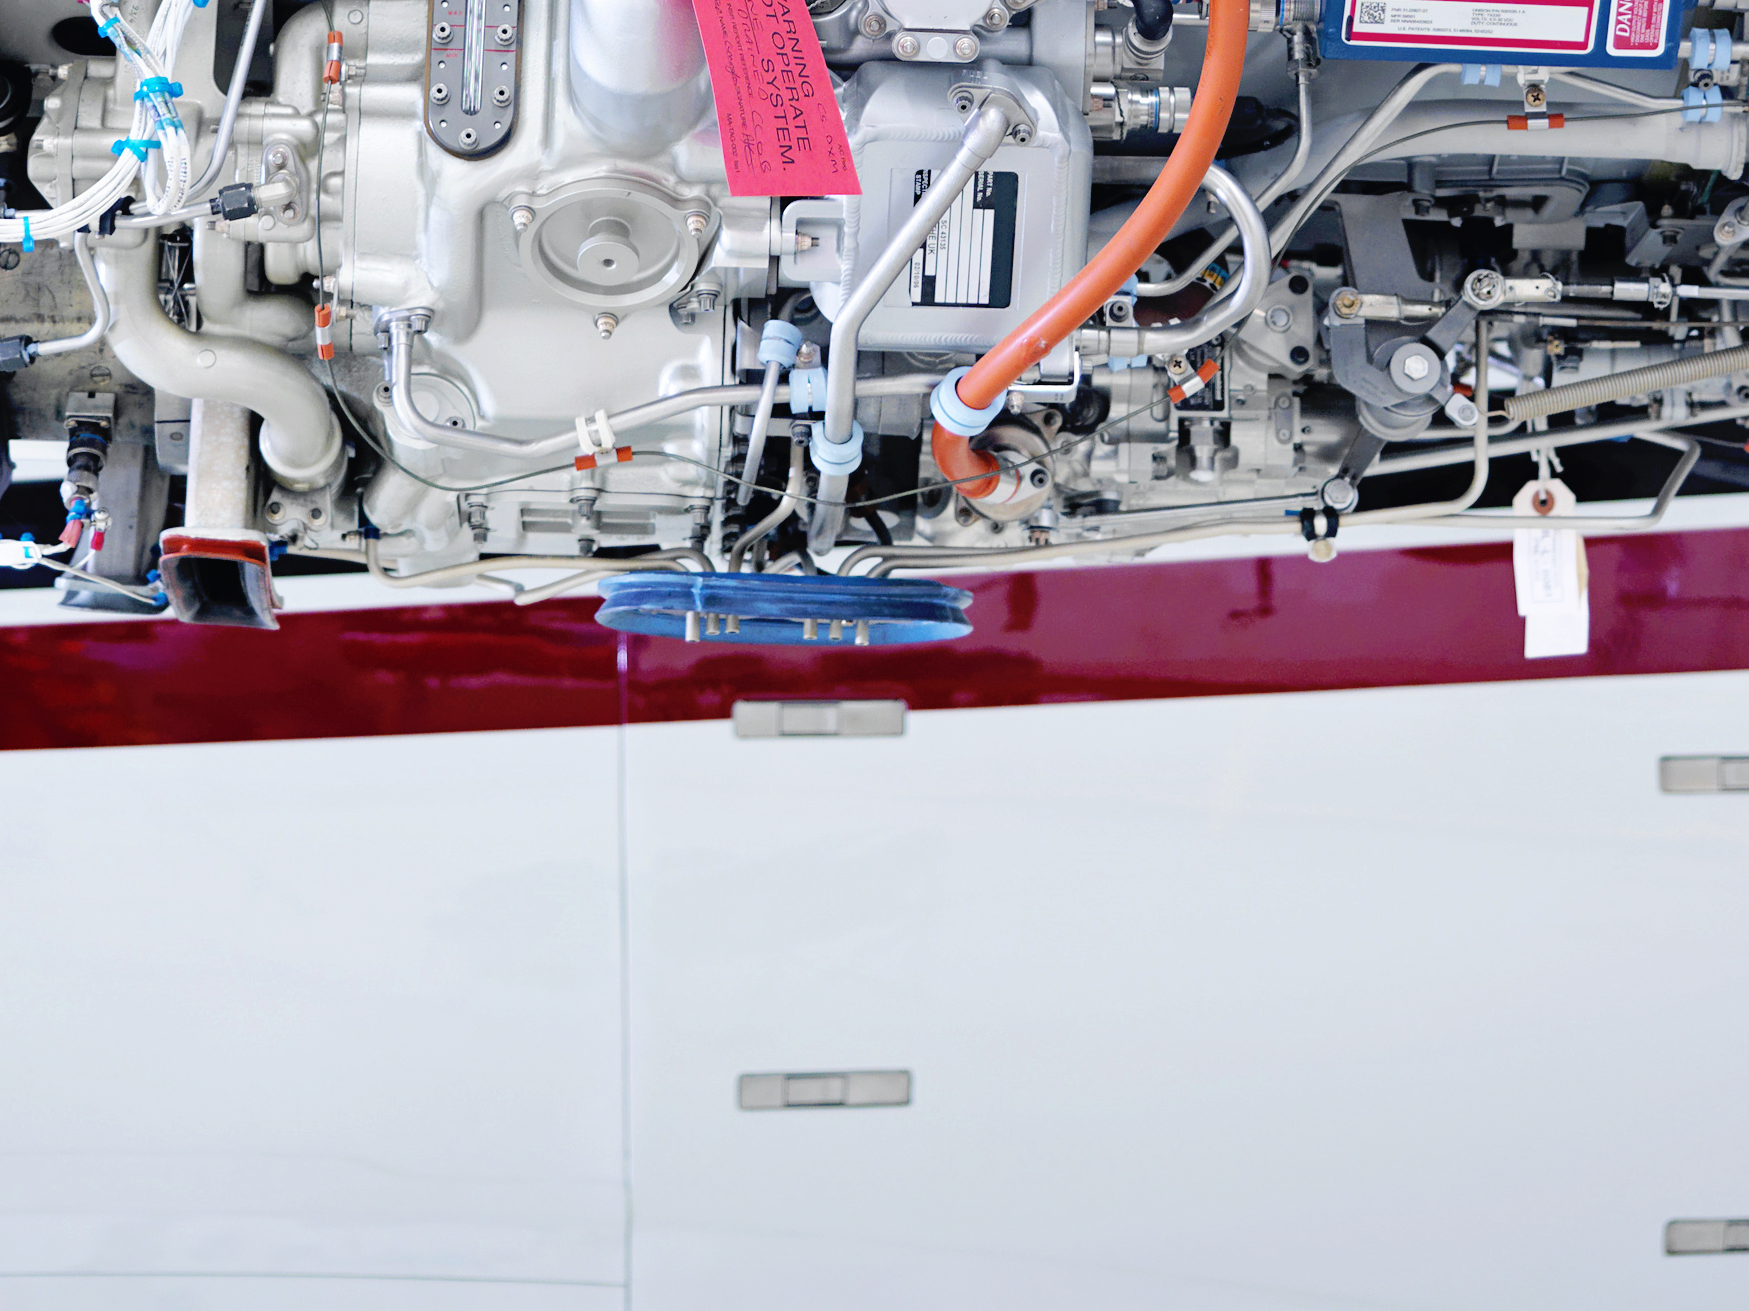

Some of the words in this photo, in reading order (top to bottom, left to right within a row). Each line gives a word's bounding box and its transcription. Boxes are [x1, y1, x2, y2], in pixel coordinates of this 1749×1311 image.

[728, 20, 743, 52] REPORT
[739, 53, 753, 97] REFERENCE
[737, 9, 768, 101] DRAINED
[761, 58, 795, 171] SYSTEM.
[772, 32, 811, 151] OPERATE
[976, 171, 984, 191] SERIAL
[986, 171, 994, 186] PART
[941, 220, 948, 229] SC
[927, 243, 936, 255] UK
